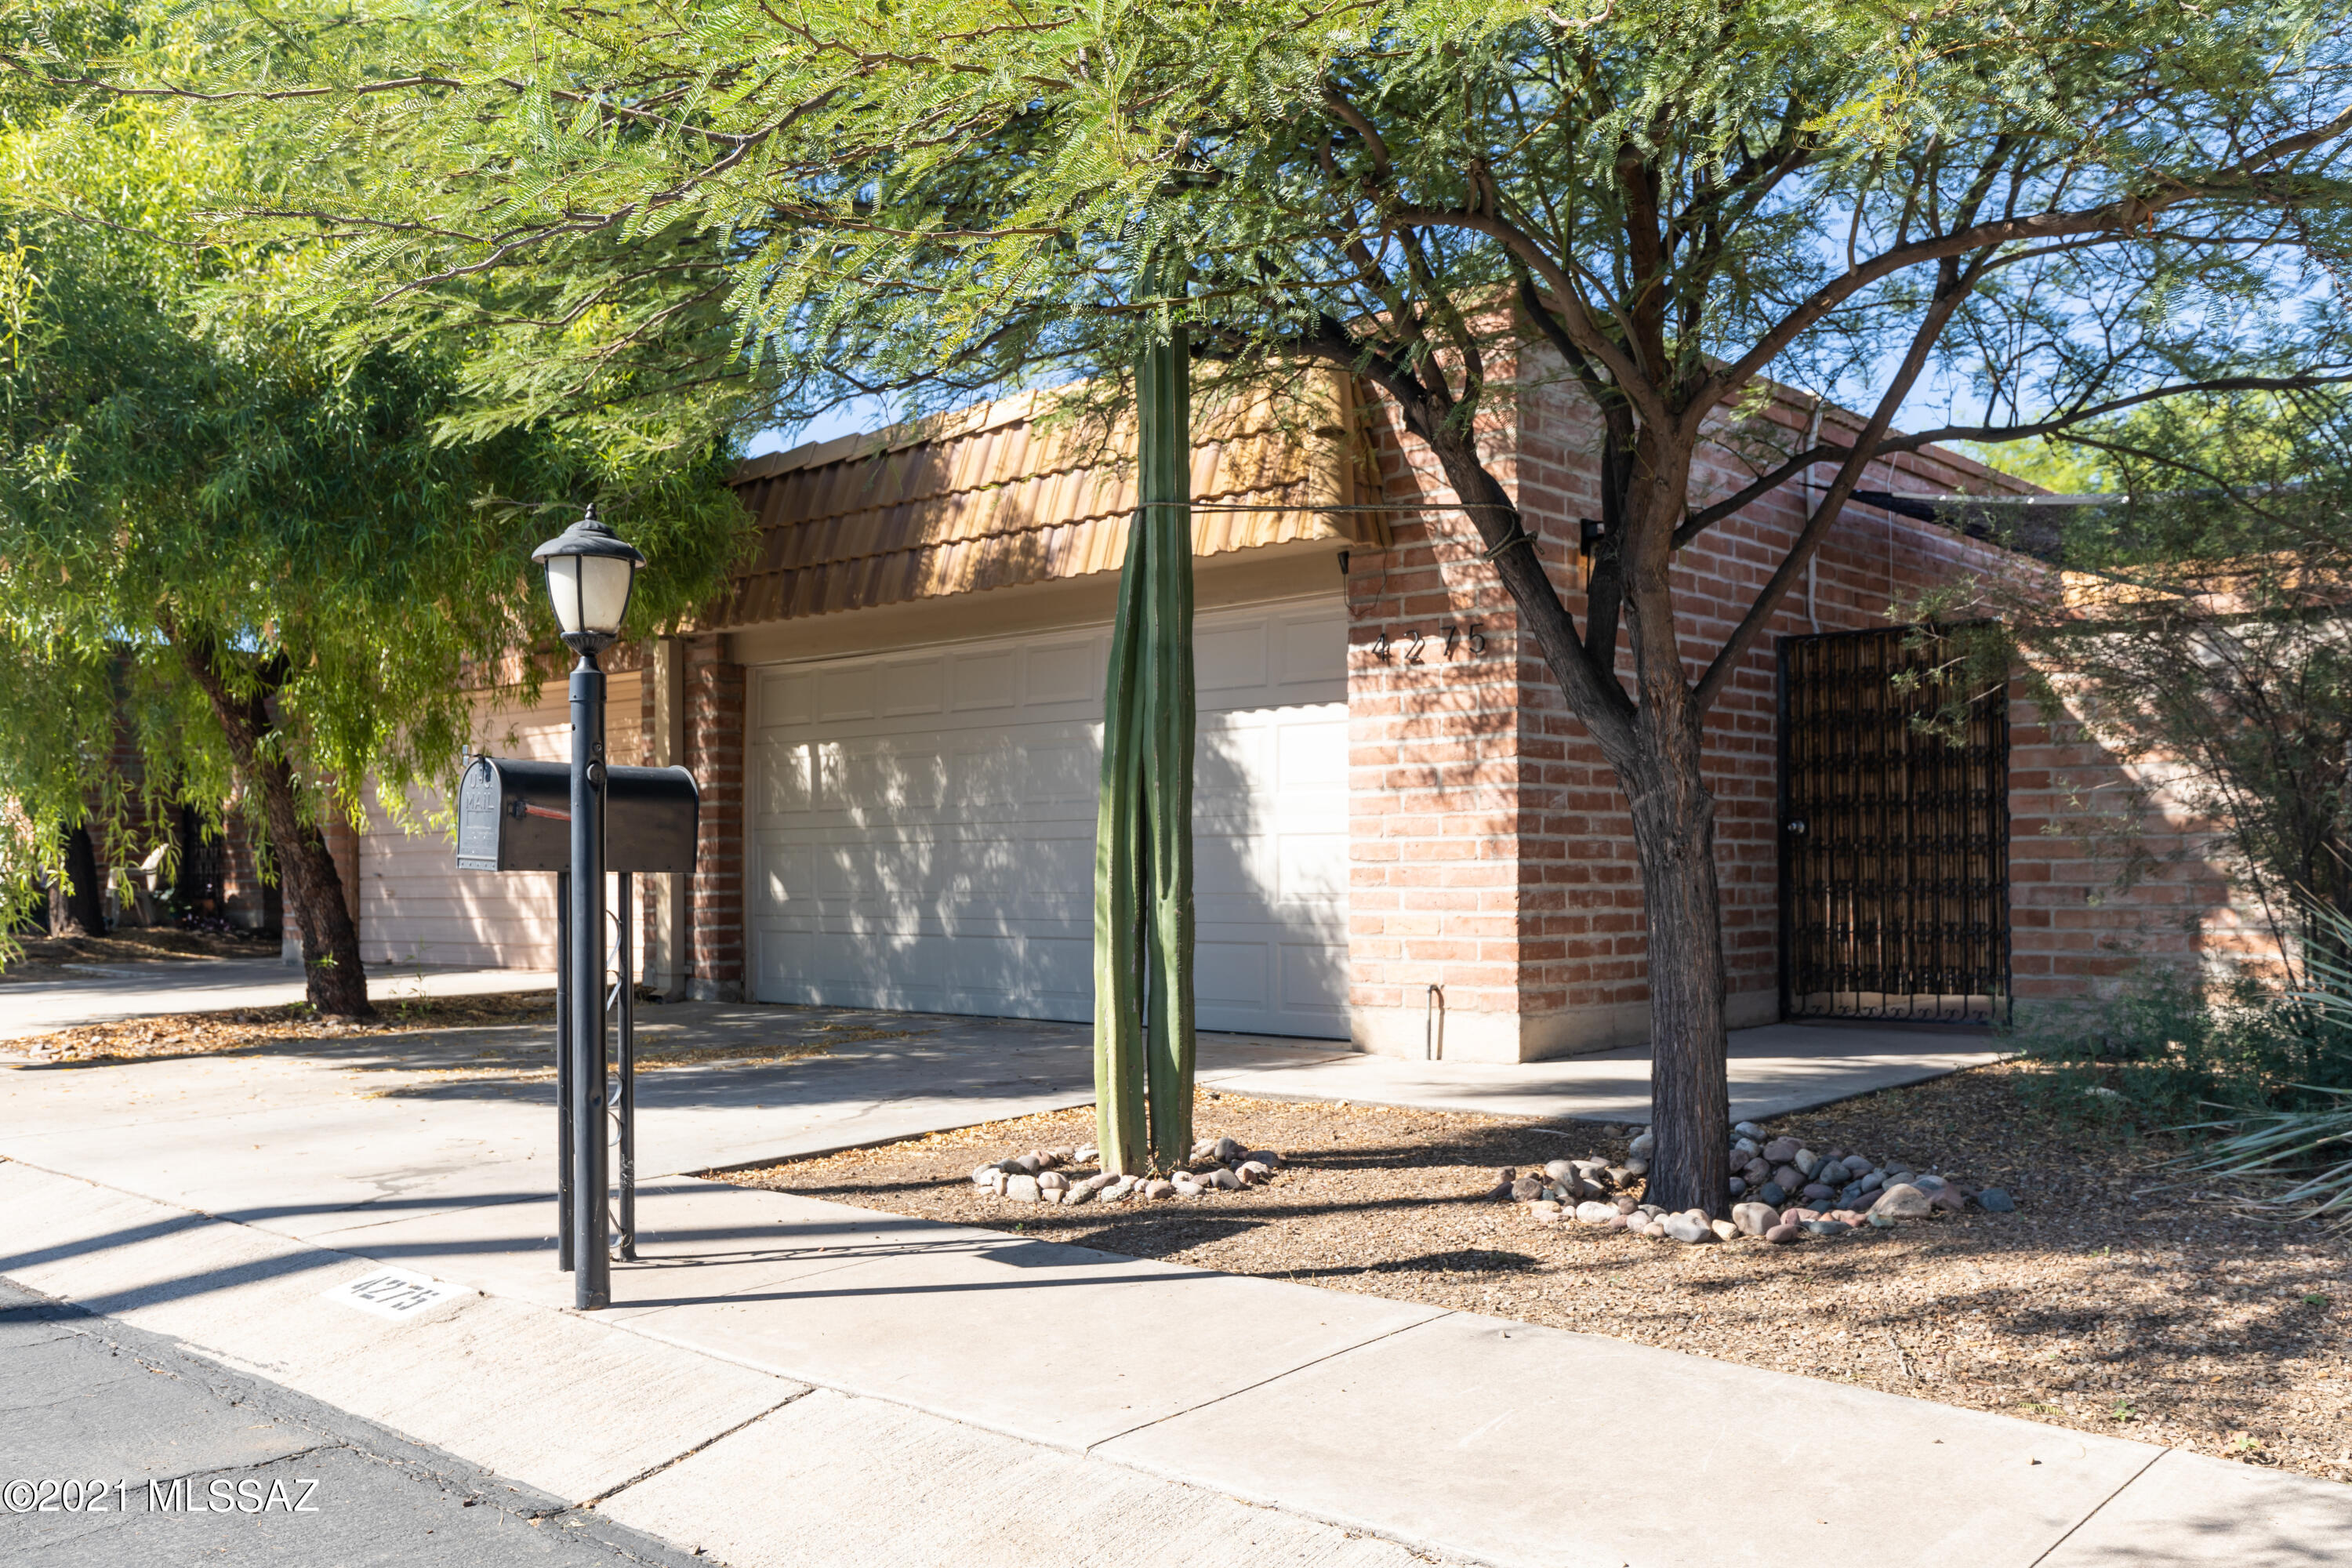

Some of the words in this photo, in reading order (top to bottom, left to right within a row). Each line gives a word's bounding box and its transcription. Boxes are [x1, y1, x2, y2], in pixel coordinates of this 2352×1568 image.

[1371, 622, 1486, 662] 4275
[466, 791, 495, 810] MAIL
[350, 1276, 441, 1311] 4275
